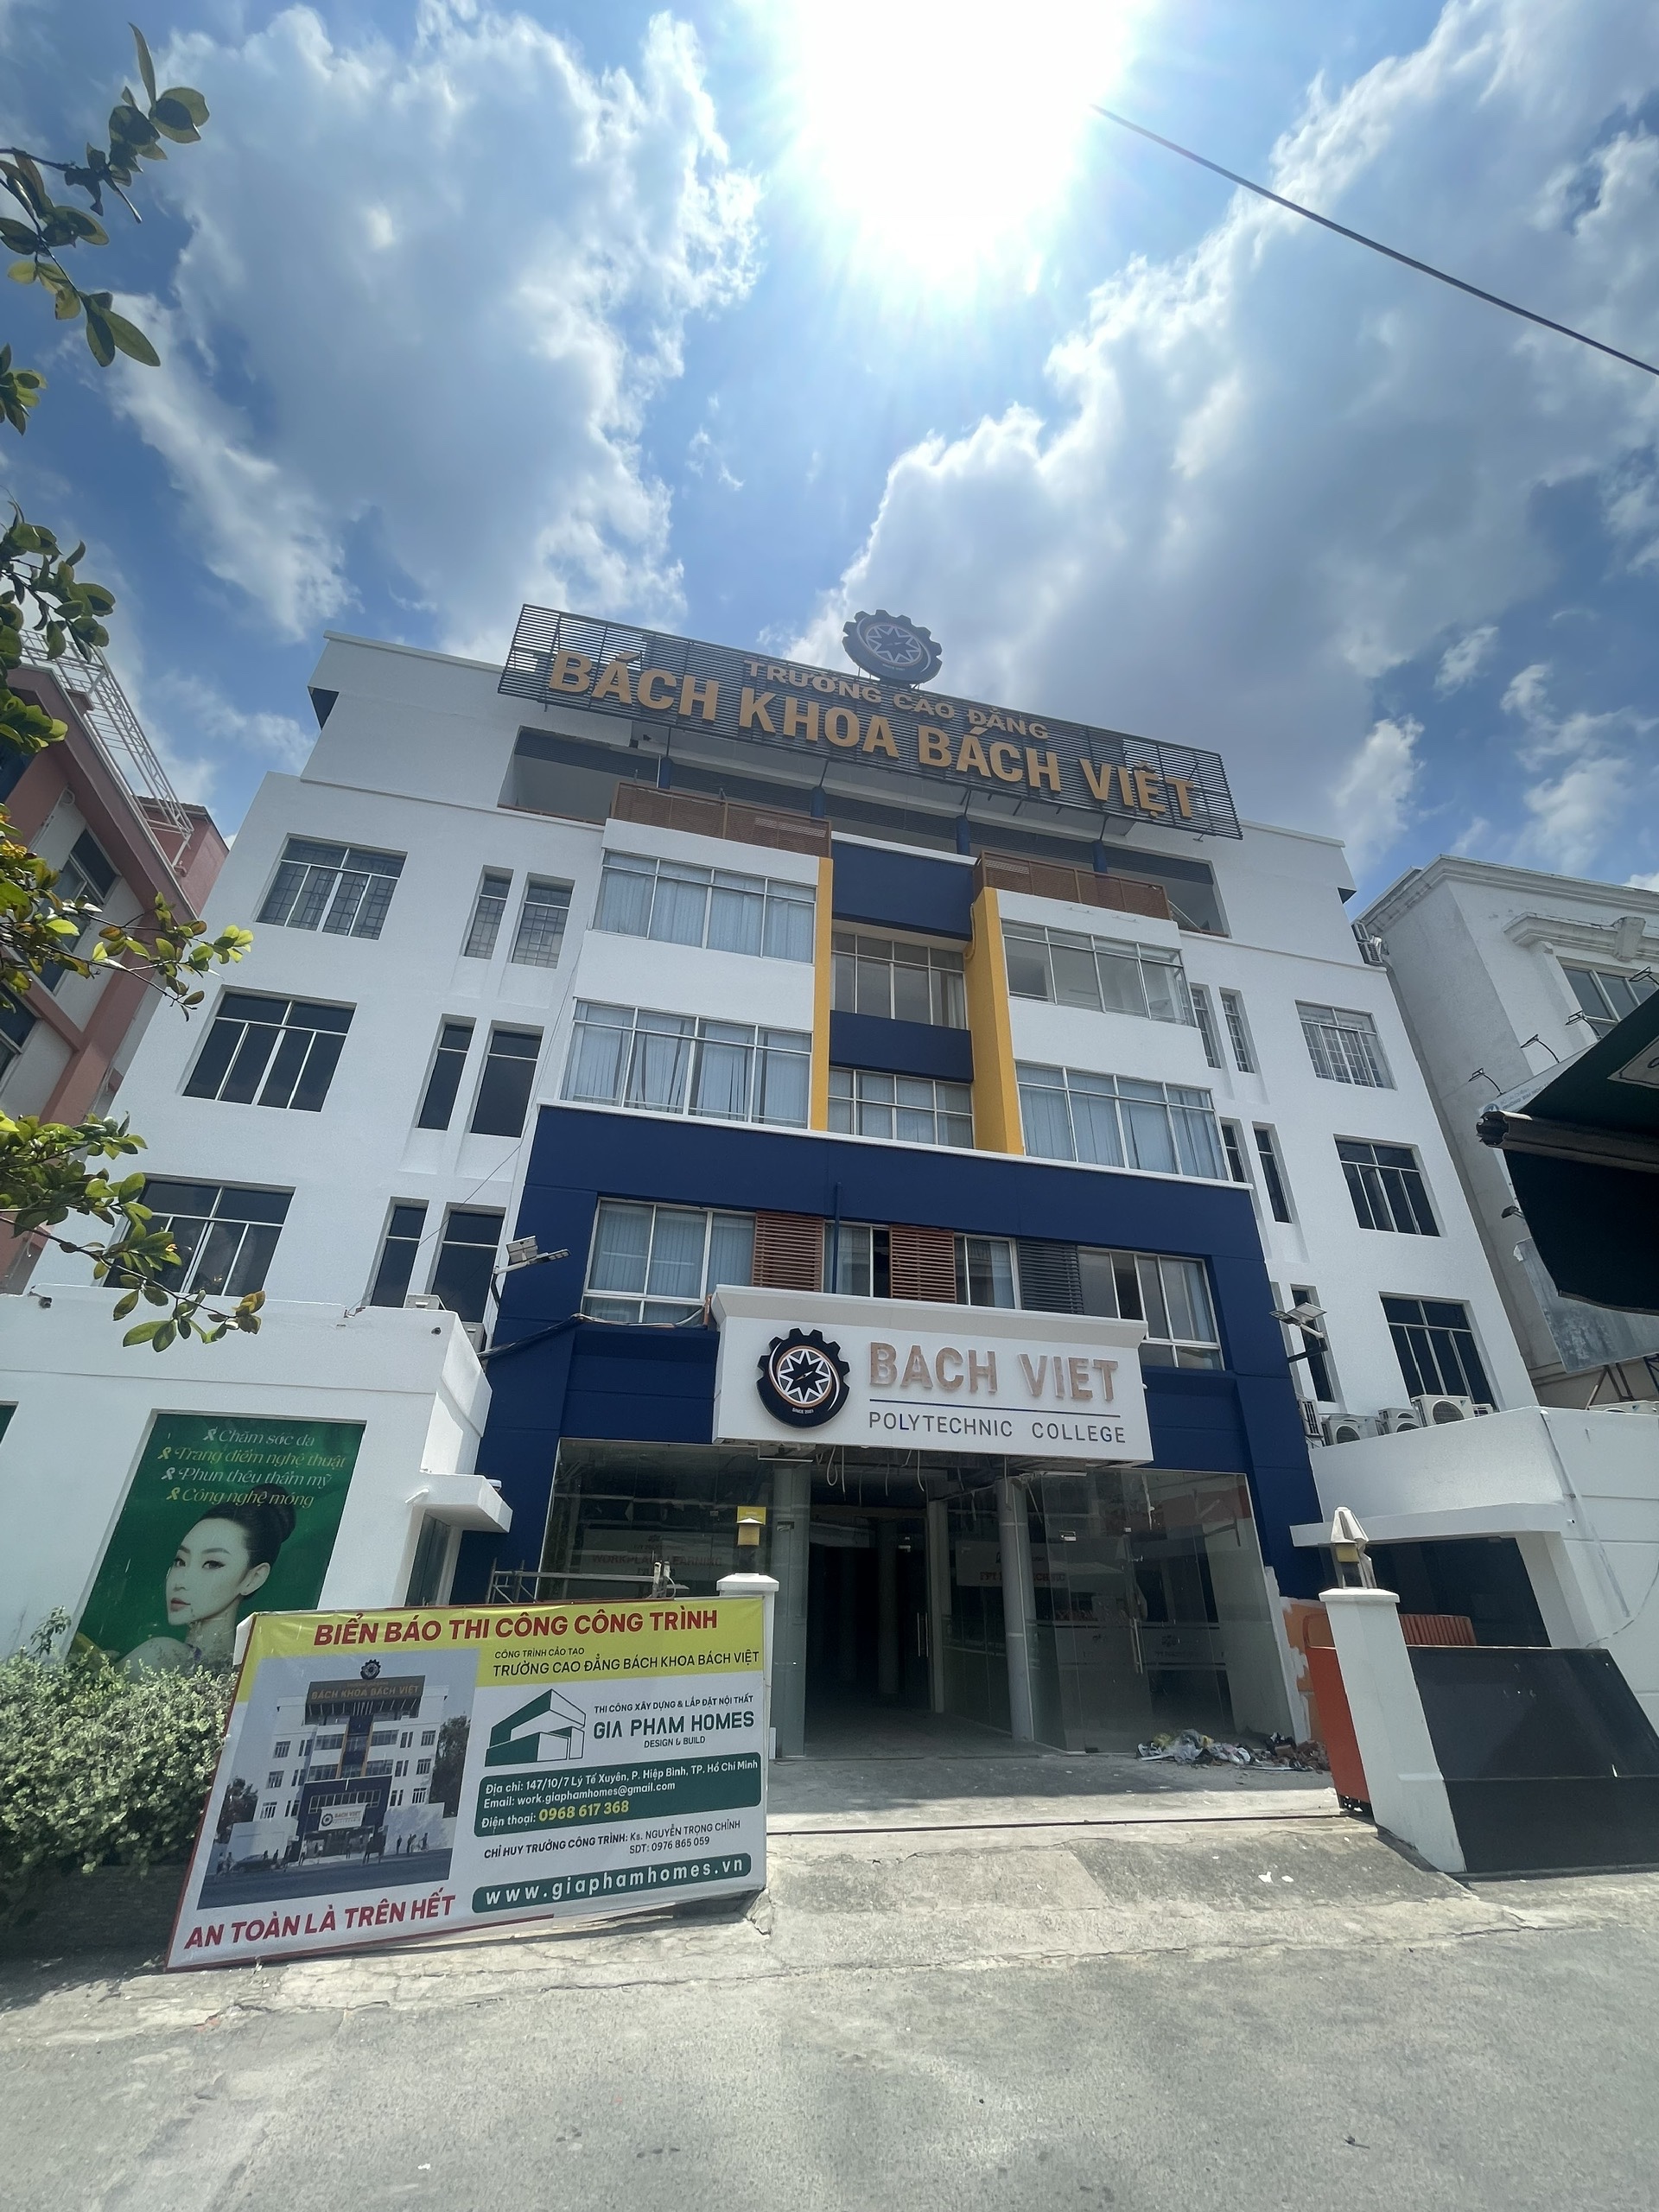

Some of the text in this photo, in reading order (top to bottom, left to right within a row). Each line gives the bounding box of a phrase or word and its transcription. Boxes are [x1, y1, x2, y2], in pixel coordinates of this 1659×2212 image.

[745, 658, 882, 704] TRƯỜNG
[893, 694, 955, 719] CAO
[549, 650, 1195, 819] BÁCH KHOA BÁCH VIỆT
[868, 1341, 1119, 1402] BACH VIET
[219, 1429, 315, 1446] Chăm sóc da
[869, 1411, 1126, 1443] POLYTECHNIC COLLEGE
[175, 1447, 222, 1464] Trang
[266, 1452, 305, 1468] nghệ
[307, 1453, 346, 1470] thuật
[178, 1467, 333, 1490] Phun thêu thẩm mỹ
[182, 1488, 315, 1508] Công nghệ móng
[314, 1605, 718, 1645] BIỂN BÁO THI CÔNG CÔNG TRÌNH
[493, 1649, 760, 1677] TRƯỜNG CAO ĐẲNG BÁCH KHOA BÁCH VIỆT
[495, 1649, 520, 1659] CÔNG
[522, 1648, 547, 1657] TRÌNH
[568, 1647, 585, 1657] TẠO
[340, 1687, 368, 1699] KHOA
[594, 1705, 607, 1713] THI
[609, 1702, 633, 1713] CÔNG
[634, 1700, 652, 1711] XÂY
[653, 1700, 676, 1711] DỰNG
[684, 1696, 701, 1707] LẮP
[702, 1697, 717, 1707] ĐẶT
[719, 1695, 733, 1707] NỘI
[734, 1693, 753, 1704] THẤT
[593, 1710, 754, 1739] GIA PHAM HOMES
[644, 1738, 674, 1749] DESIGN
[683, 1735, 706, 1745] BUILD
[486, 1783, 503, 1796] Địa
[505, 1780, 524, 1792] chỉ:
[526, 1777, 570, 1790] 147/10/7
[571, 1775, 583, 1787] Lý
[598, 1772, 629, 1786] Xuyên,
[632, 1770, 641, 1780] P.
[643, 1768, 664, 1780] Hiệp
[665, 1766, 689, 1777] Bình,
[691, 1764, 705, 1775] TP.
[707, 1761, 720, 1773] Hồ
[721, 1760, 735, 1771] Chí
[737, 1759, 758, 1770] Minh
[484, 1782, 676, 1808] Email: work.giaphamhomes@gmail.com
[481, 1800, 629, 1830] Điện thoại: 0968 617 368
[484, 1844, 502, 1859] CHỈ
[503, 1845, 524, 1857] HUY
[526, 1839, 566, 1854] TRƯỞNG
[568, 1836, 595, 1848] CÔNG
[598, 1832, 628, 1846] TRÌNH:
[630, 1832, 643, 1841] Ks.
[645, 1823, 682, 1840] NGUYỄN
[683, 1823, 713, 1836] TRỌNG
[630, 1835, 710, 1854] SDT: 0976 865 059
[486, 1857, 743, 1906] www.giaphamhomes.vn
[184, 1887, 456, 1949] AN TOÀN LÀ TRÊN HẾT
